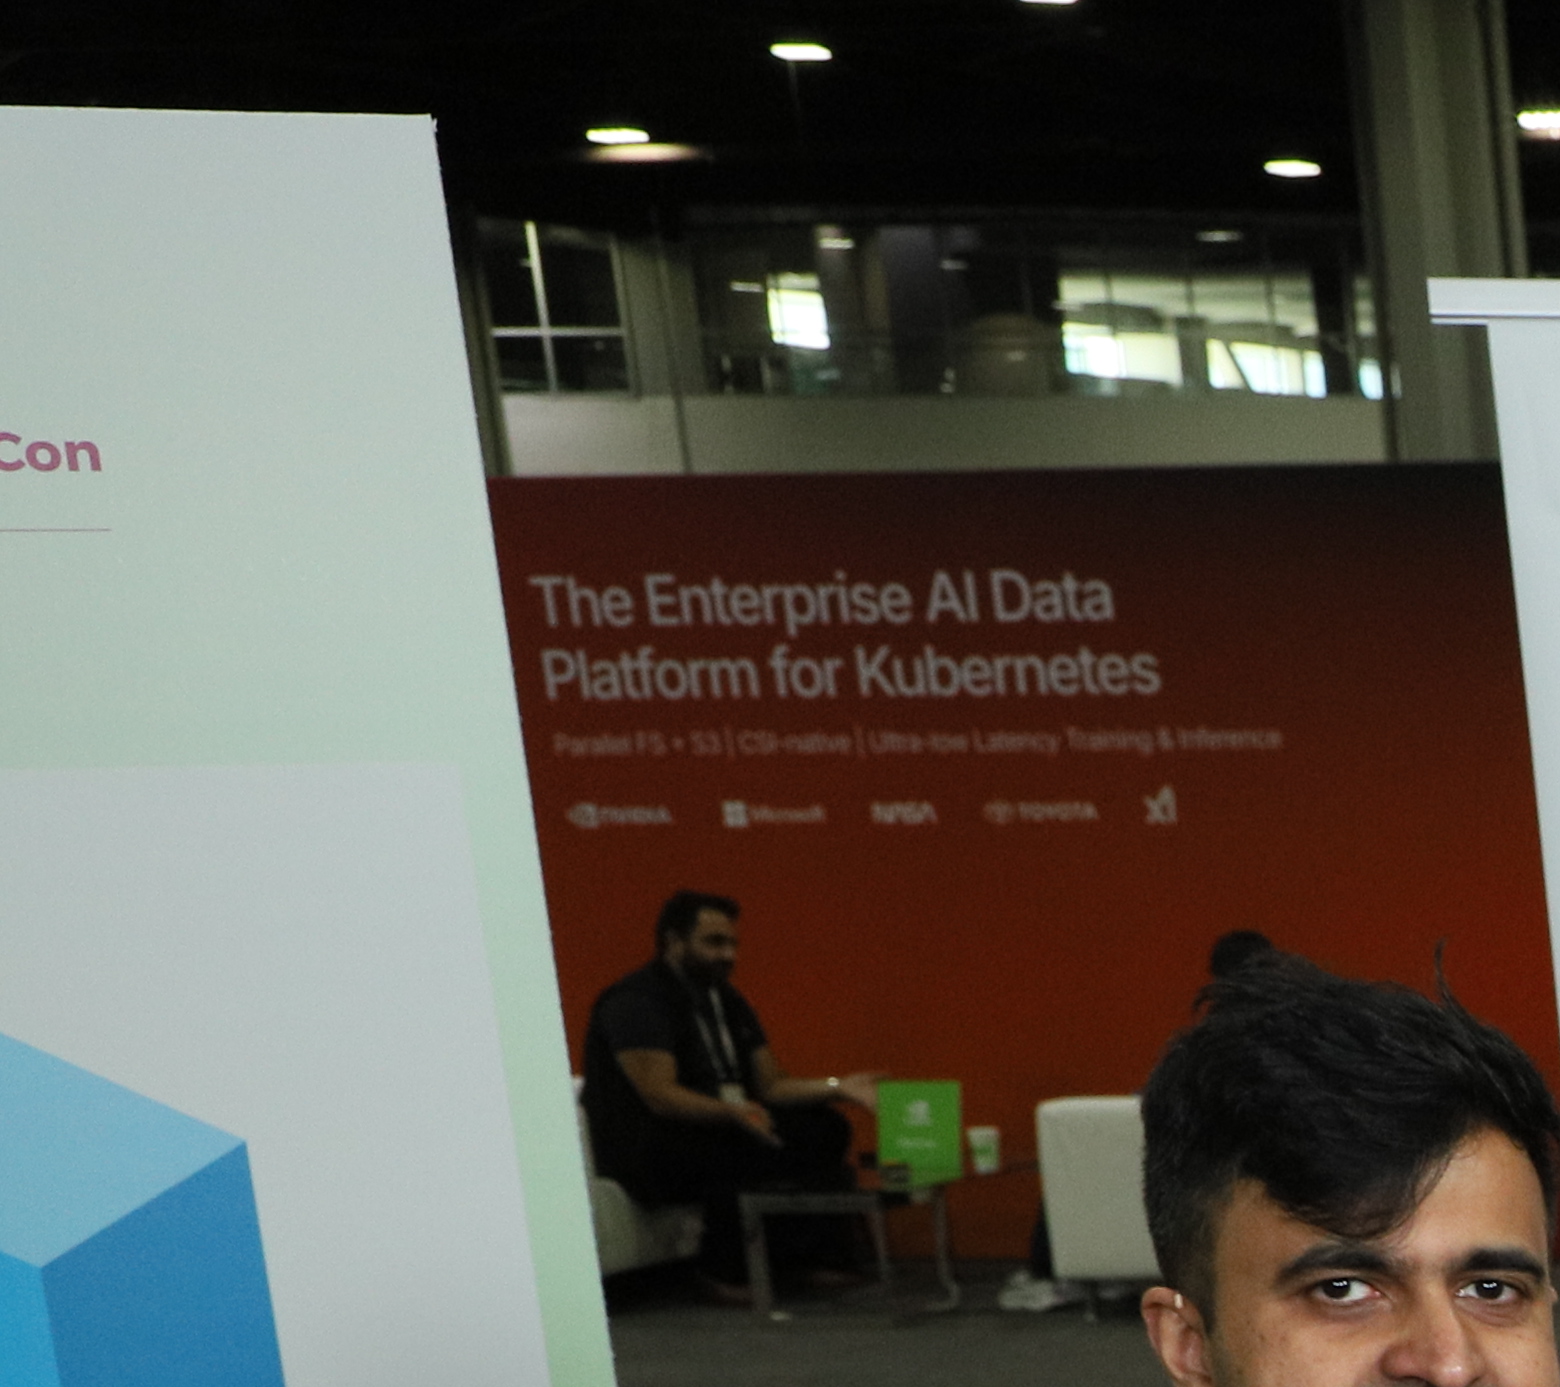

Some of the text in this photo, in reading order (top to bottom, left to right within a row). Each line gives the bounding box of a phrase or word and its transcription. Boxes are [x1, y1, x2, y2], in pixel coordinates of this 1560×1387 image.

[0, 432, 102, 472] Con
[529, 567, 1116, 637] The Enterprise AI Data
[541, 642, 1162, 700] Platform for Kubernetes
